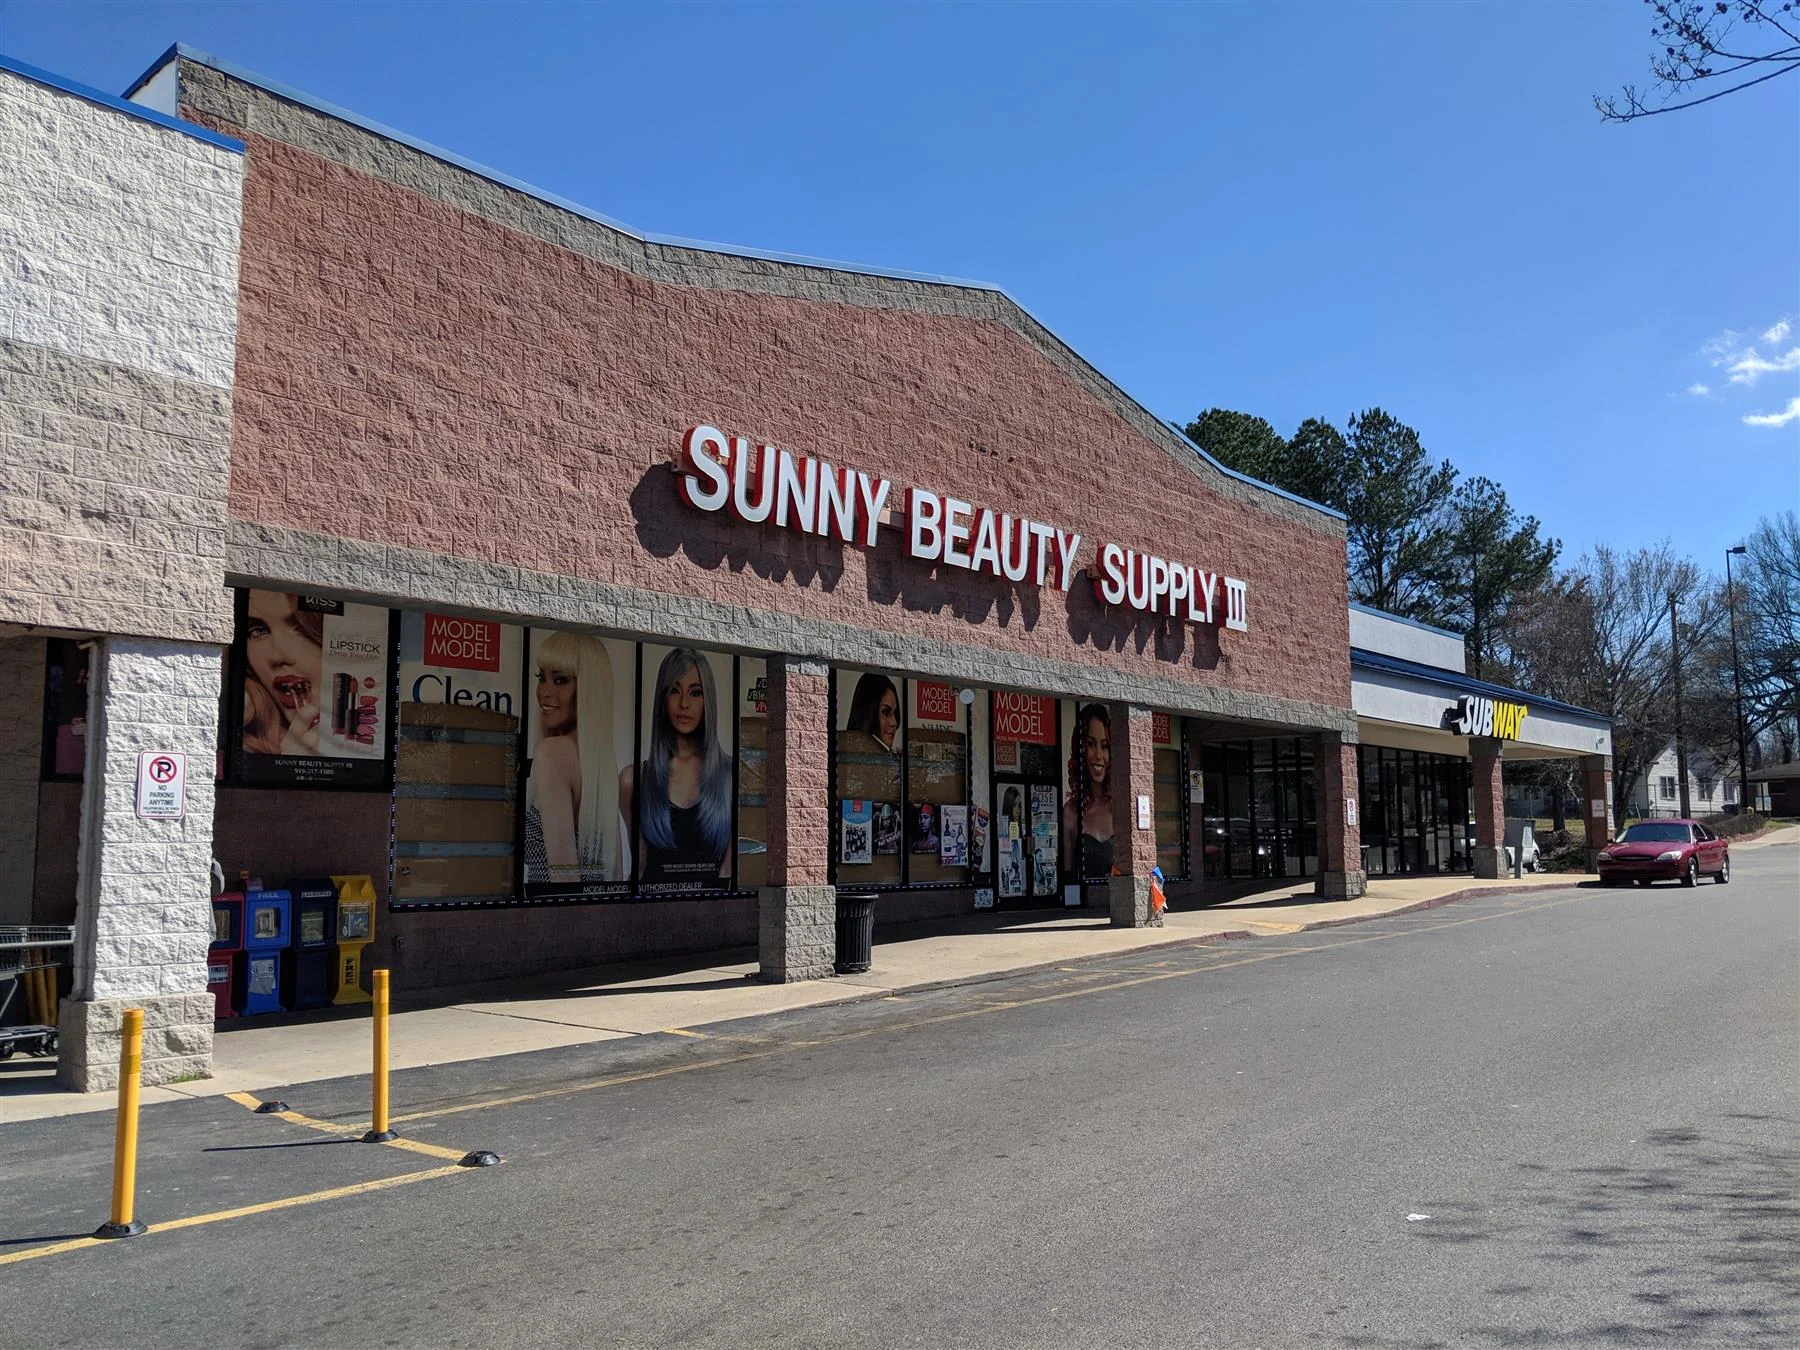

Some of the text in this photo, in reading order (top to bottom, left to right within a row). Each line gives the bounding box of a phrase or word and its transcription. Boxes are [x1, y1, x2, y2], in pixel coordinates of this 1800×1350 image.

[683, 426, 1248, 633] SUNNY BEAUTY SUPPLY III
[305, 596, 338, 608] KISS
[431, 618, 492, 643] MODEL
[330, 640, 380, 654] LIPSTICK
[430, 638, 492, 661] MODEL
[412, 674, 512, 717] Clean
[921, 687, 953, 701] MODEL
[921, 700, 953, 714] MODEL
[996, 691, 1044, 714] MODEL
[996, 713, 1044, 736] MODEL
[1152, 714, 1169, 727] ODEL
[1457, 694, 1528, 742] SUBWAY
[1152, 727, 1169, 739] ODEL
[298, 760, 322, 768] BEAUTY
[149, 791, 175, 799] PARKING
[158, 784, 168, 792] NO
[583, 885, 605, 893] MODEL
[678, 881, 703, 891] DEALER
[345, 959, 355, 985] FREE
